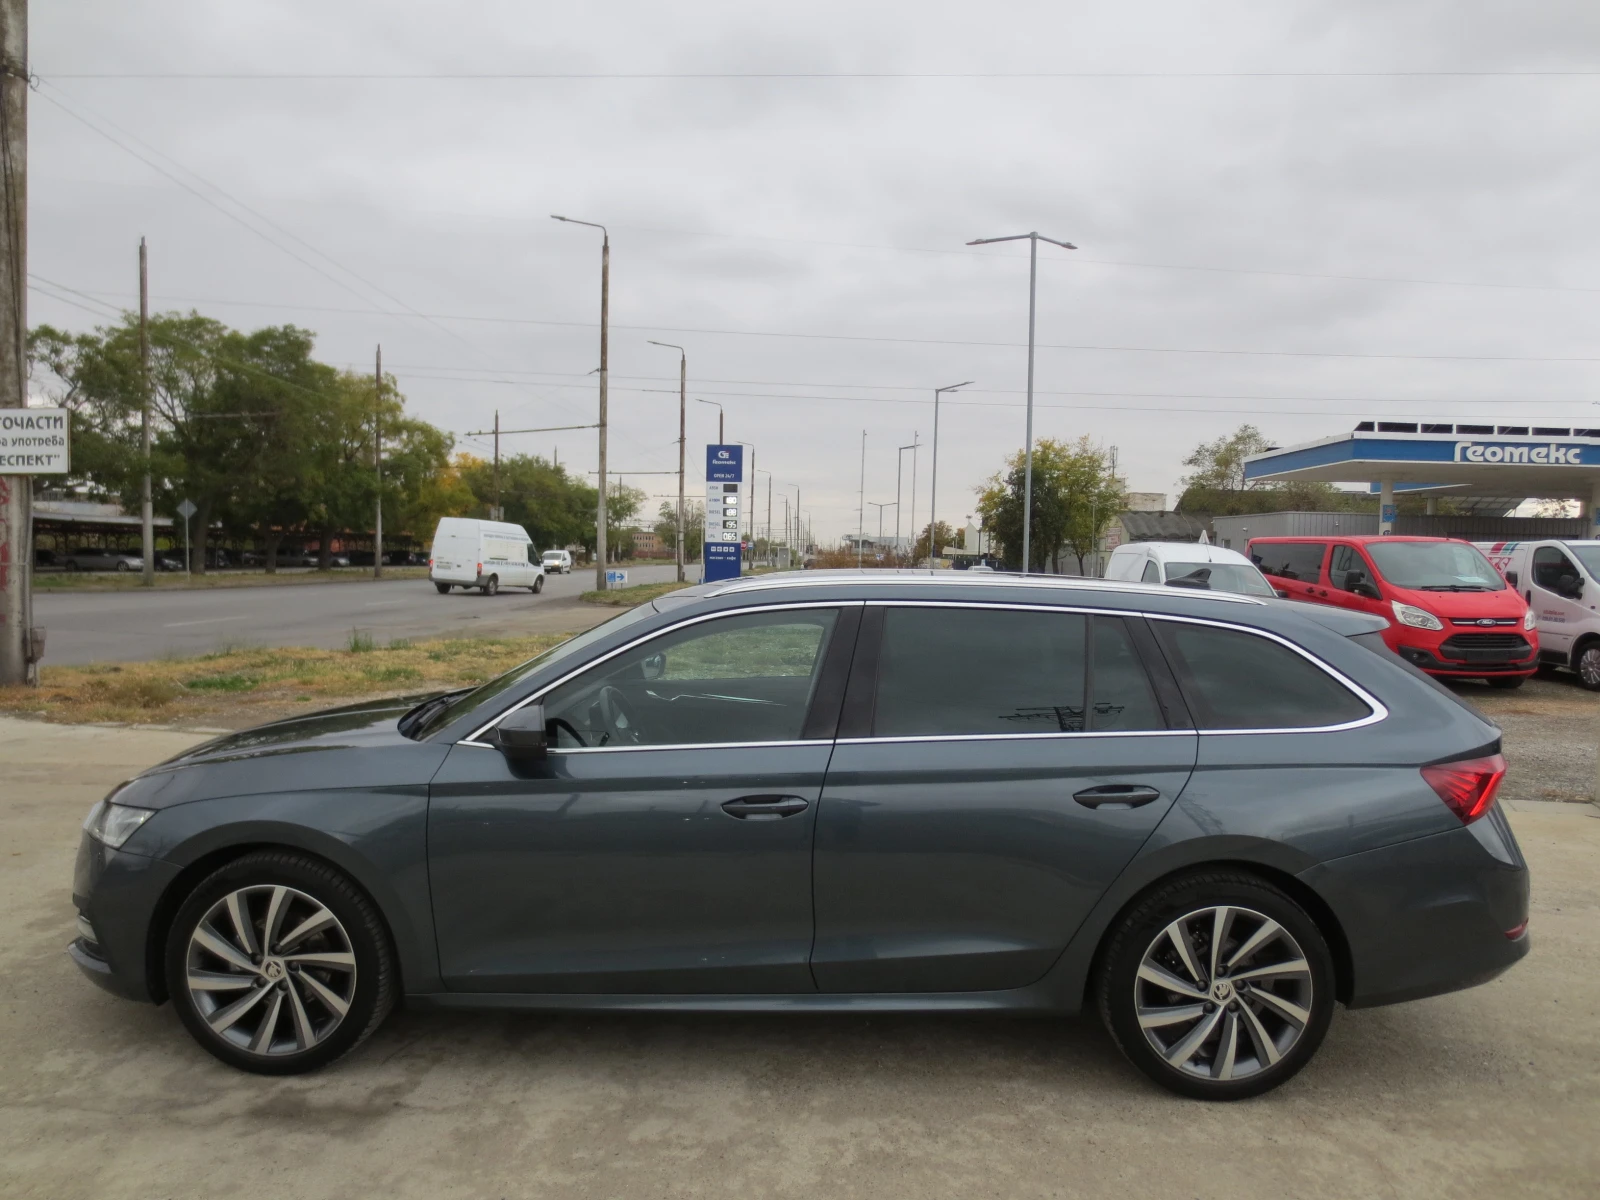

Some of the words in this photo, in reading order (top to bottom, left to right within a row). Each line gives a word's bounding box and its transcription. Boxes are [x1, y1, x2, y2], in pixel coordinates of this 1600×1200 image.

[0, 416, 64, 430] ОЧАСТИ
[0, 437, 8, 447] а
[11, 435, 65, 447] употреба
[1454, 441, 1581, 464] Геомекс
